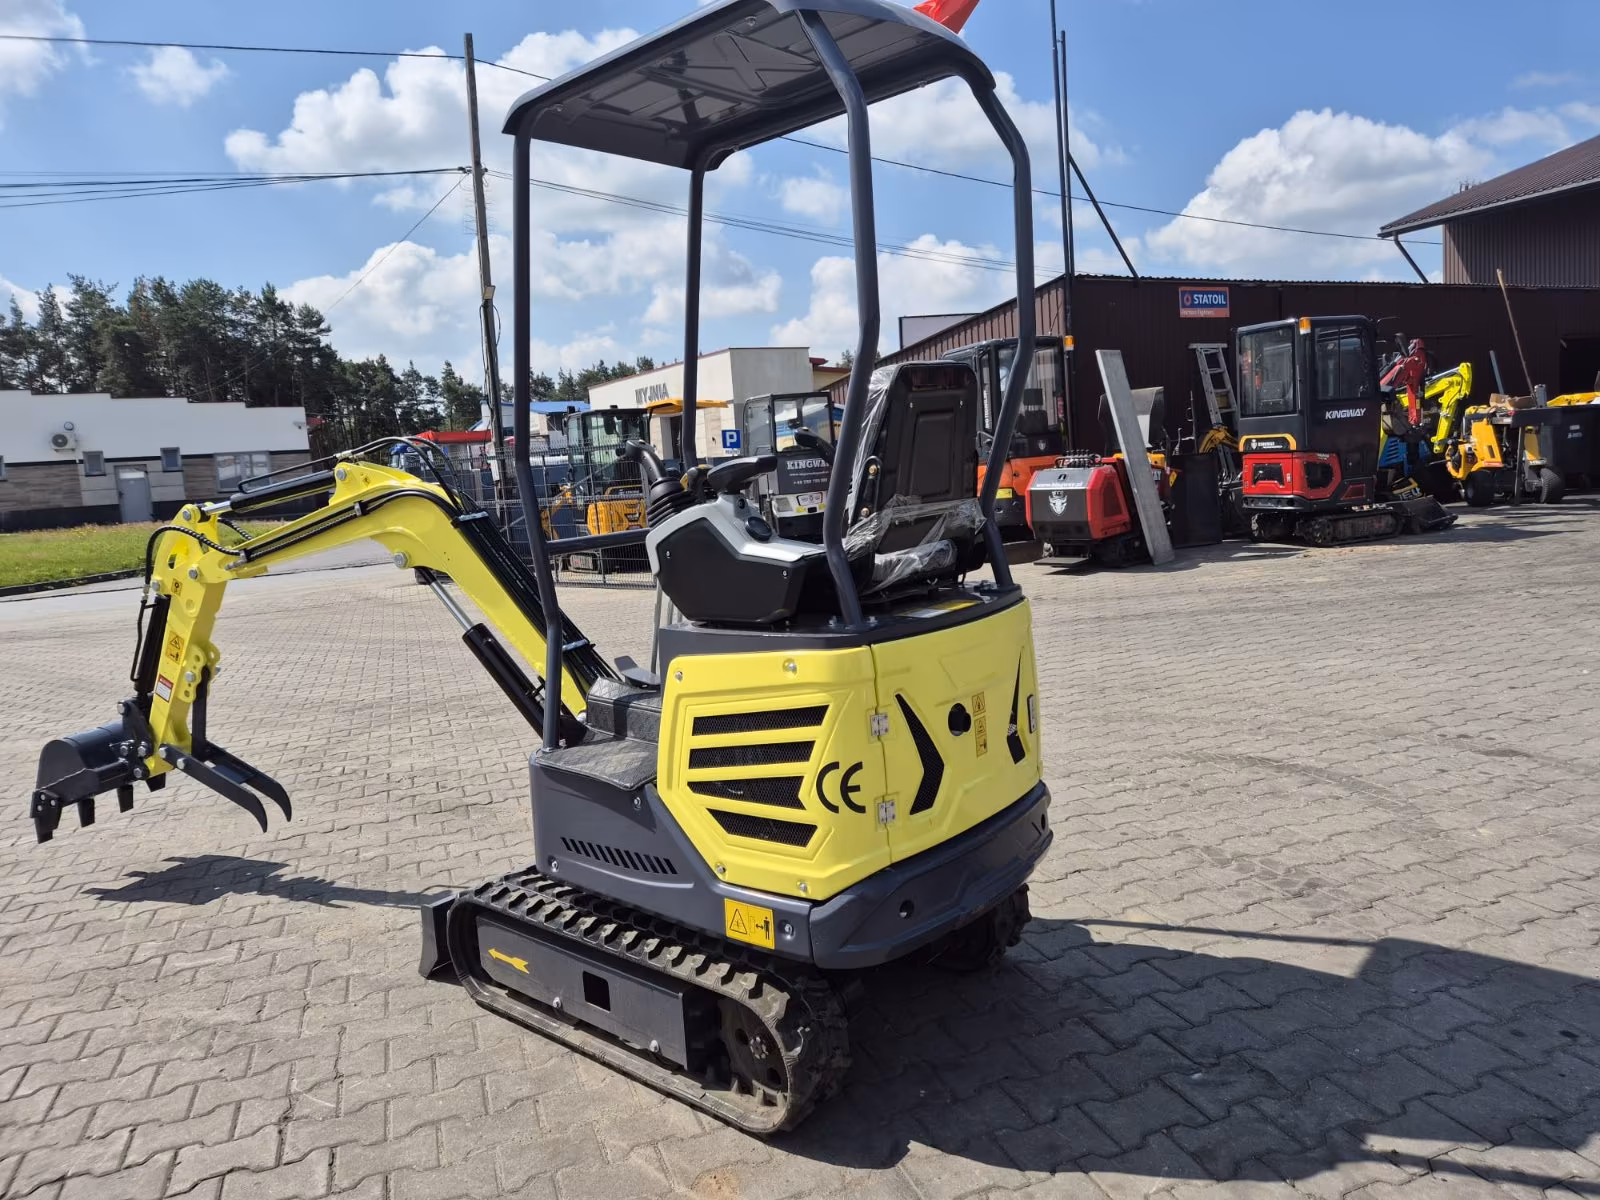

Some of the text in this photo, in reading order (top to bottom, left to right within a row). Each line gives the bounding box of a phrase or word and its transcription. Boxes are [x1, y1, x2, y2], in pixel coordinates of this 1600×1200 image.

[1193, 294, 1226, 304] STATOIL
[1325, 408, 1366, 419] KINGWAY
[725, 431, 738, 447] P
[815, 761, 867, 814] CE
